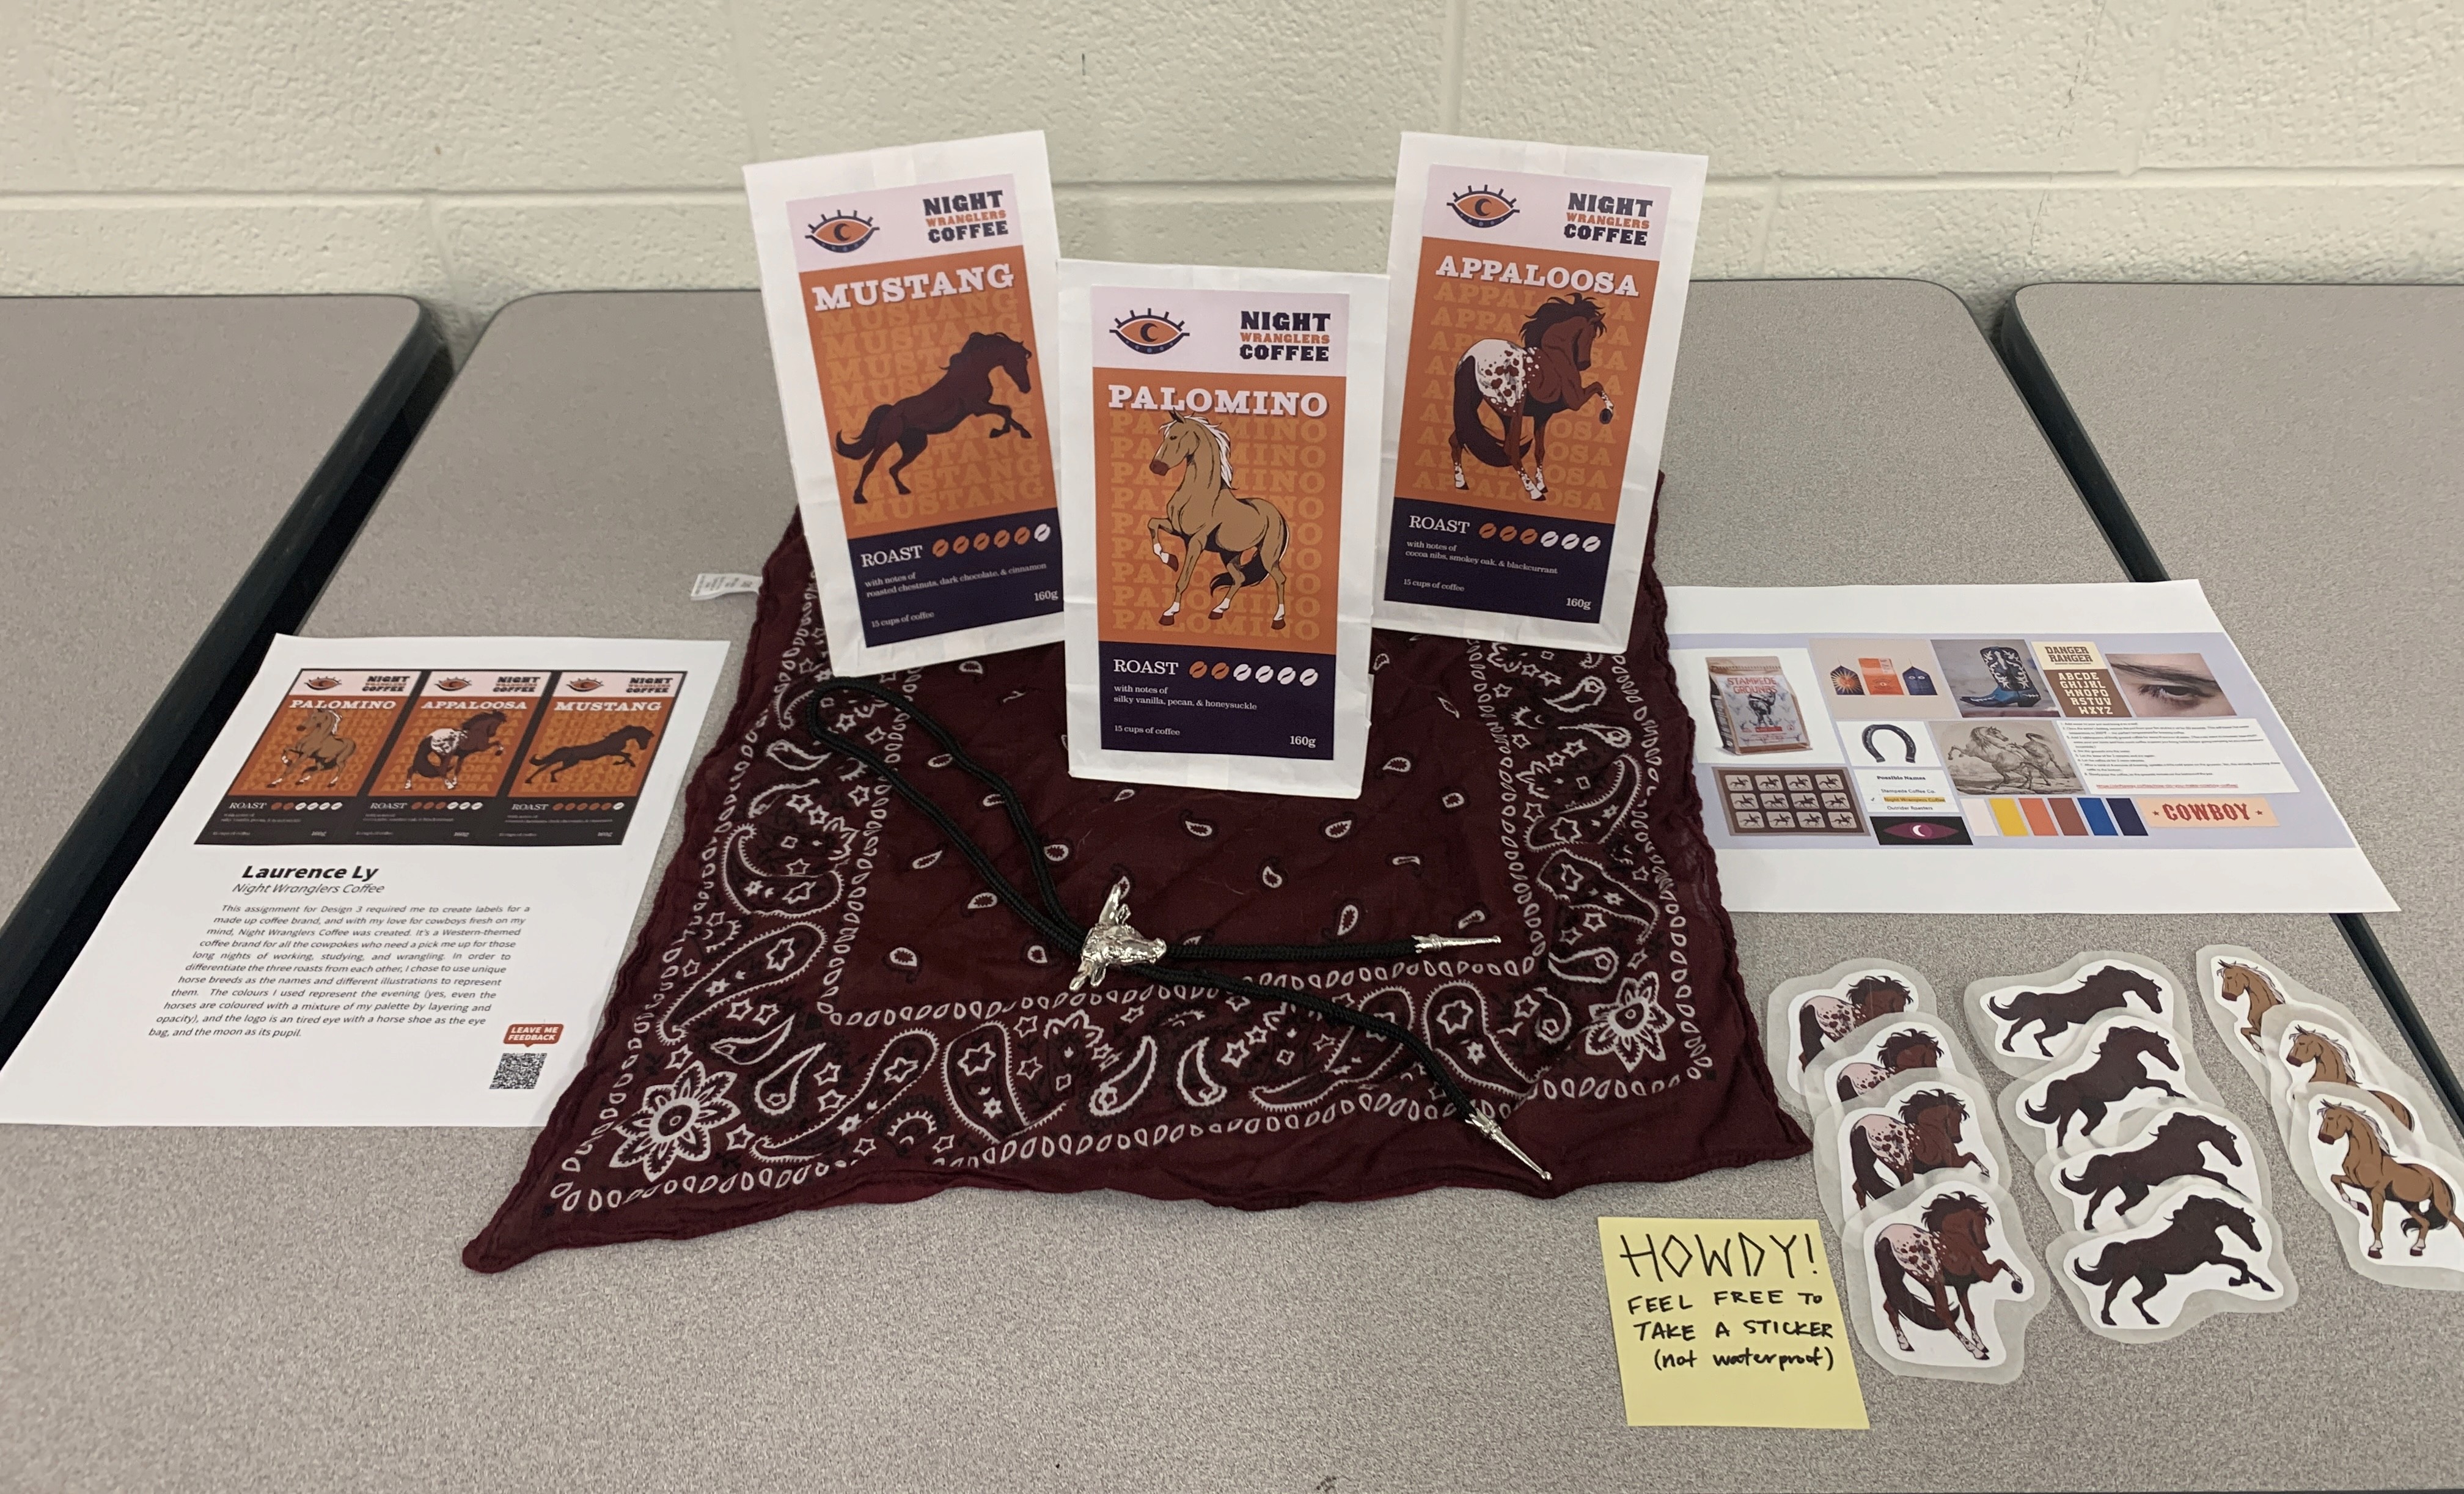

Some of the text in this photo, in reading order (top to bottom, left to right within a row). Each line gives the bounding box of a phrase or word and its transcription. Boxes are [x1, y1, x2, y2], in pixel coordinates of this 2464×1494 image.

[923, 190, 1003, 216] NIGHT
[1568, 192, 1653, 218] NIGHT
[925, 210, 1007, 227] WRANGLERS
[1566, 212, 1650, 229] WRANGLERS
[928, 220, 1008, 244] COFFEE
[1563, 224, 1648, 246] COFFEE
[1436, 255, 1640, 298] APPALOOSA
[812, 263, 1014, 312] MUSTANG
[1240, 311, 1331, 332] NIGHT
[1239, 332, 1330, 344] WRANGLERS
[1239, 344, 1329, 362] COFFEE
[1108, 385, 1329, 418] PALOMINO
[1409, 515, 1470, 534] ROAST
[1406, 540, 1425, 550] with
[1426, 543, 1447, 551] notes
[860, 545, 923, 568] ROAST
[1449, 554, 1480, 565] smokey
[1507, 561, 1558, 575] blackcurrant
[865, 572, 917, 587] with notes of
[867, 586, 897, 598] roasted
[939, 575, 958, 586] dark
[1008, 562, 1047, 574] cinnamon
[1412, 580, 1431, 589] cups
[1441, 583, 1465, 592] coffee
[1033, 590, 1058, 602] 160g
[1566, 597, 1591, 611] 160g
[880, 617, 900, 627] cups
[911, 611, 935, 622] coffee
[1113, 659, 1179, 675] ROAST
[289, 700, 397, 709] PALOMINO
[420, 701, 527, 710] APPALOOSA
[554, 702, 662, 712] MUSTANG
[1113, 696, 1134, 704] silky
[1135, 696, 1166, 705] vanilla,
[1205, 699, 1258, 710] honeysuckle
[1289, 735, 1316, 748] 160g
[2162, 803, 2251, 822] COWBOY
[241, 865, 379, 882] Laurence Ly
[232, 883, 385, 896] Night Wranglers Coffee
[320, 905, 353, 914] Design
[365, 905, 407, 914] required
[425, 917, 467, 925] cowboys
[207, 929, 235, 937] mind,
[238, 929, 266, 938] Night
[268, 929, 316, 938] Wranglers
[148, 1028, 170, 1038] bag,
[172, 1028, 194, 1036] and
[271, 1028, 302, 1038] pupil.
[1619, 1232, 1821, 1282] HOWDY!
[1627, 1294, 1693, 1315] FEEL
[1714, 1290, 1783, 1305] FREE
[1633, 1319, 1833, 1341] TAKE A STICKER
[1654, 1346, 1834, 1371] (not waterproof)
